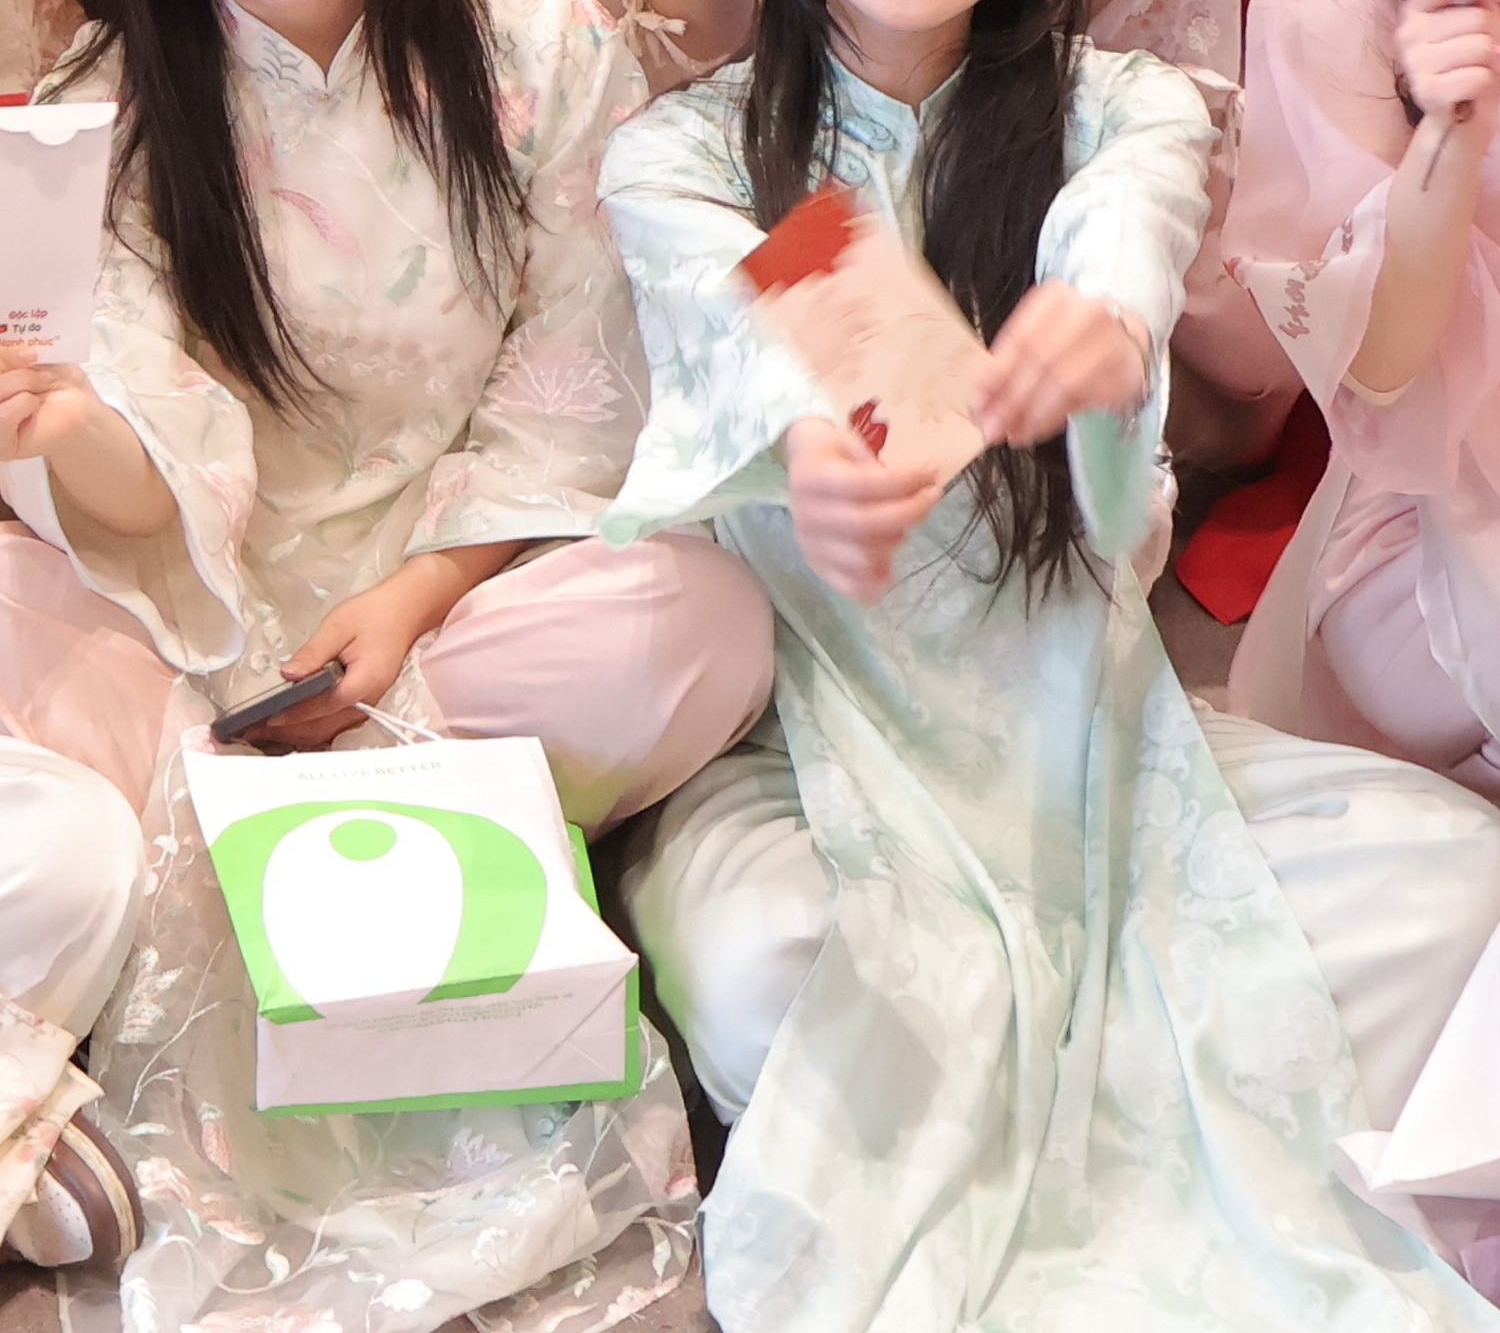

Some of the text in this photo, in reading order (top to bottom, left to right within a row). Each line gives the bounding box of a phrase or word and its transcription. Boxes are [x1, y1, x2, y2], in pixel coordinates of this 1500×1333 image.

[297, 760, 443, 782] ALL LIVE BETTER
